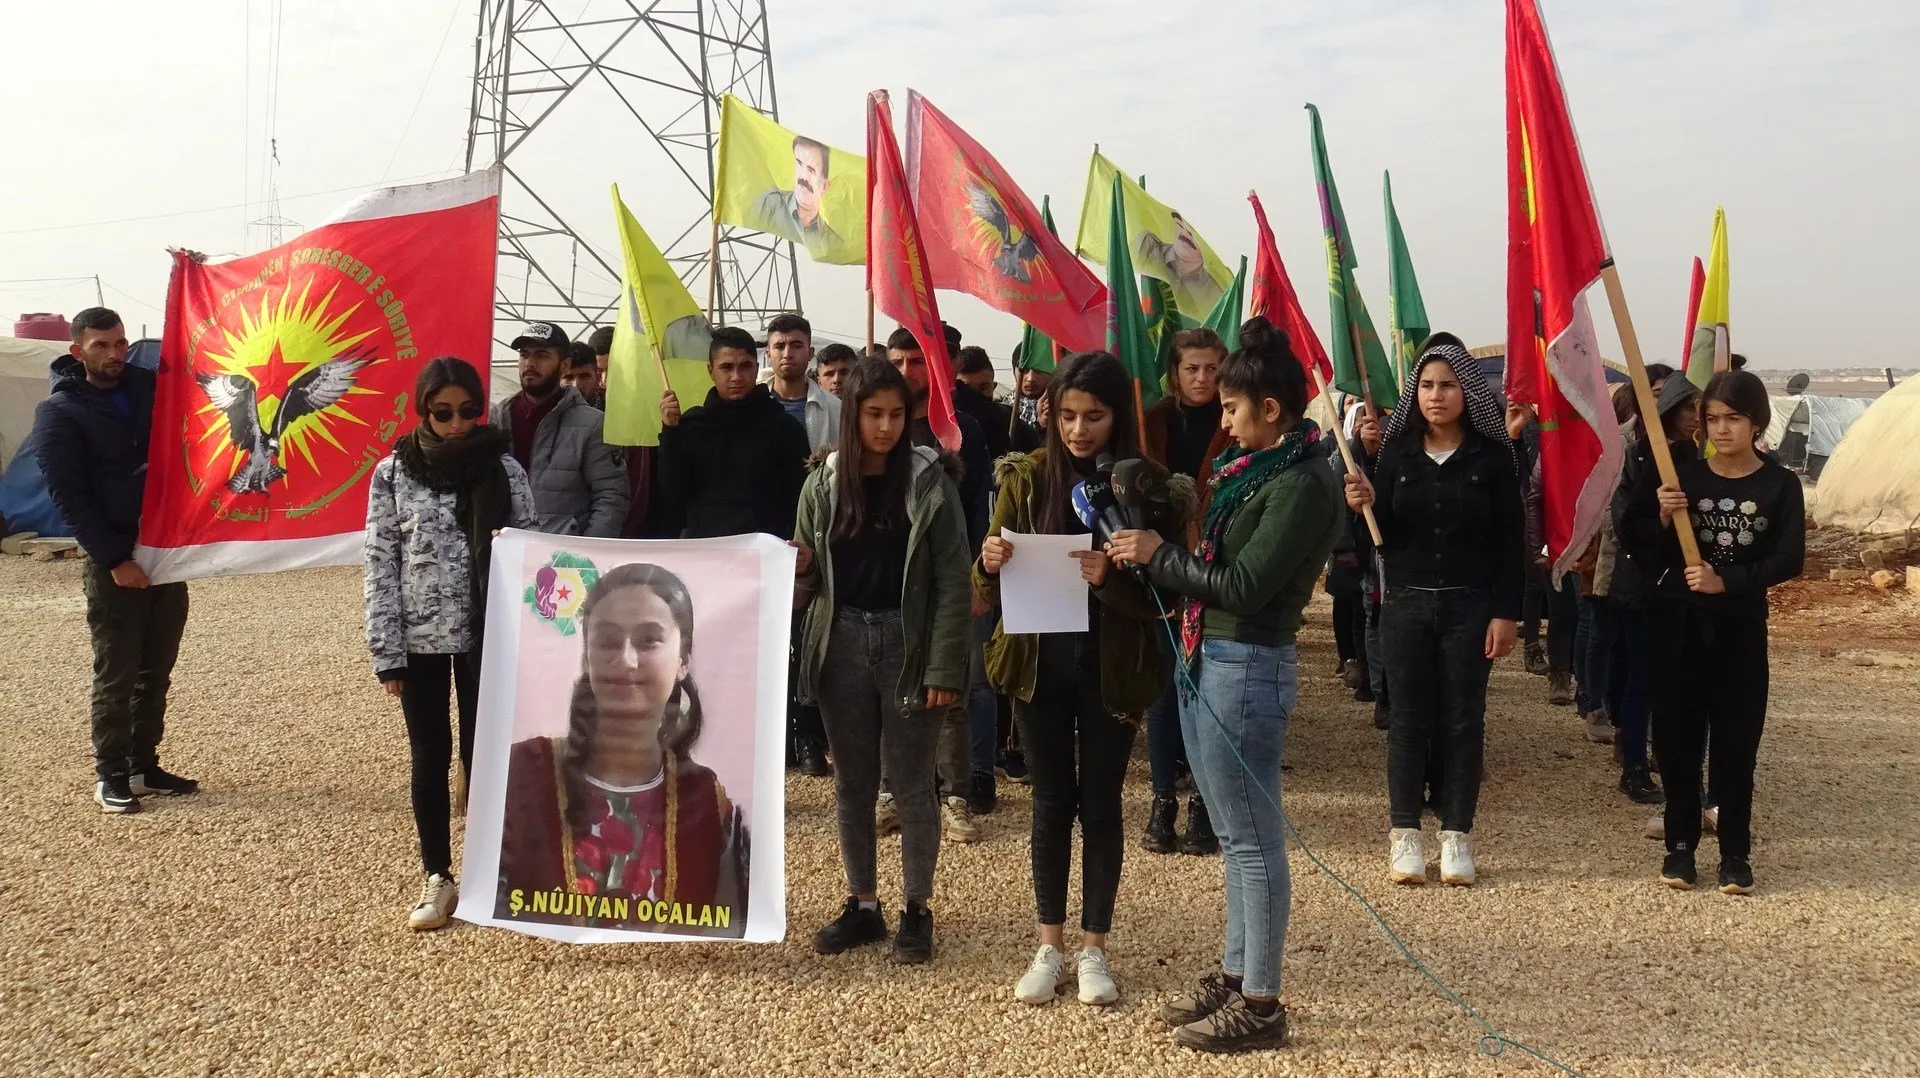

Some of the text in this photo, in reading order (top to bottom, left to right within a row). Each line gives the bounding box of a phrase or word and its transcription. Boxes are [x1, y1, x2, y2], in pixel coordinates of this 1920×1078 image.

[373, 391, 409, 443] حركة
[509, 886, 731, 928] Ş.NÛJIYAN OCALAN
